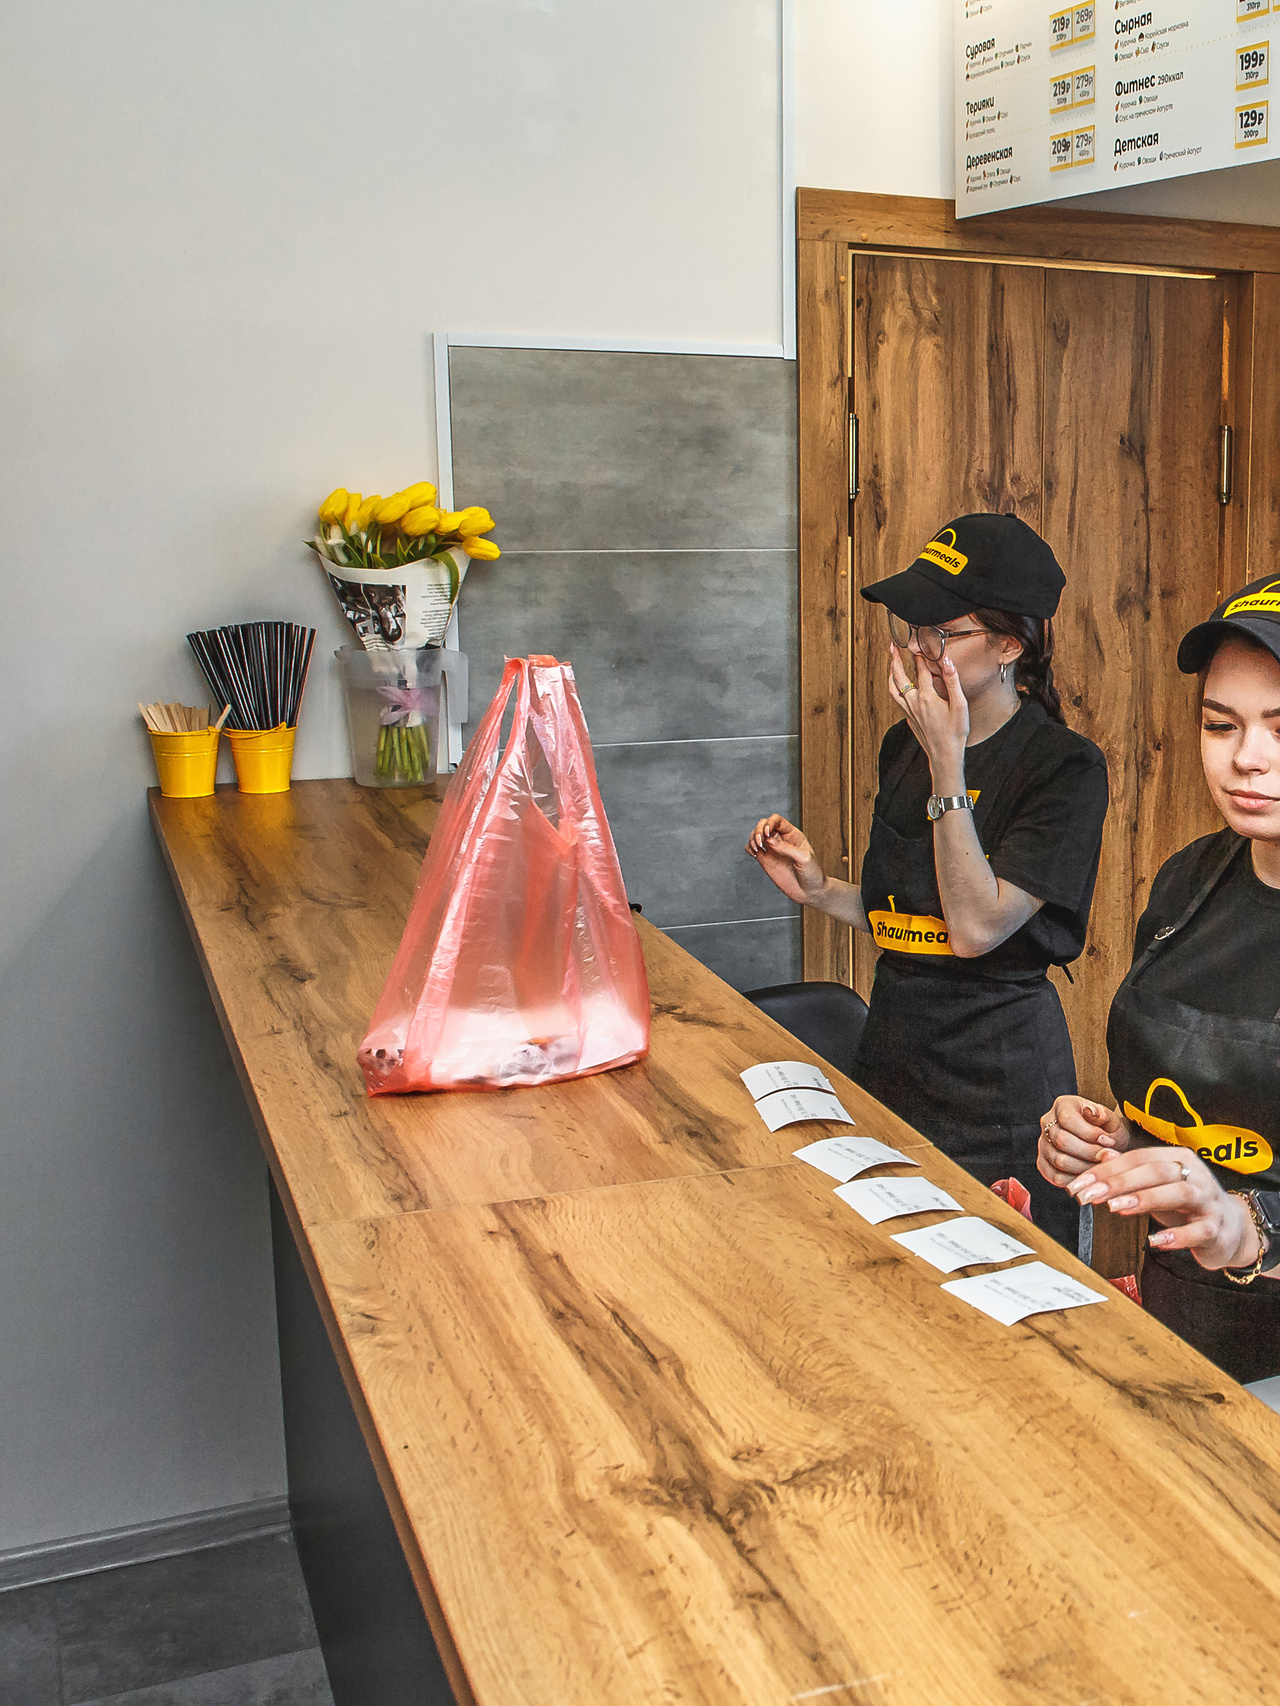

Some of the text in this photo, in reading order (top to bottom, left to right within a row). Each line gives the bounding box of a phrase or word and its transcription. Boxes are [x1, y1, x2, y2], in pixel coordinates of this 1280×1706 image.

[1115, 12, 1152, 34] Сырная
[966, 38, 995, 60] Суровая
[1115, 72, 1184, 96] Фитнес 290ккал
[966, 96, 995, 116] Терияки
[1239, 110, 1264, 129] 129₽
[1114, 133, 1159, 156] Детская
[1244, 130, 1259, 138] 200гр
[966, 146, 1013, 171] Деревенская
[876, 921, 948, 944] Shaurmea
[1196, 1136, 1258, 1162] eals
